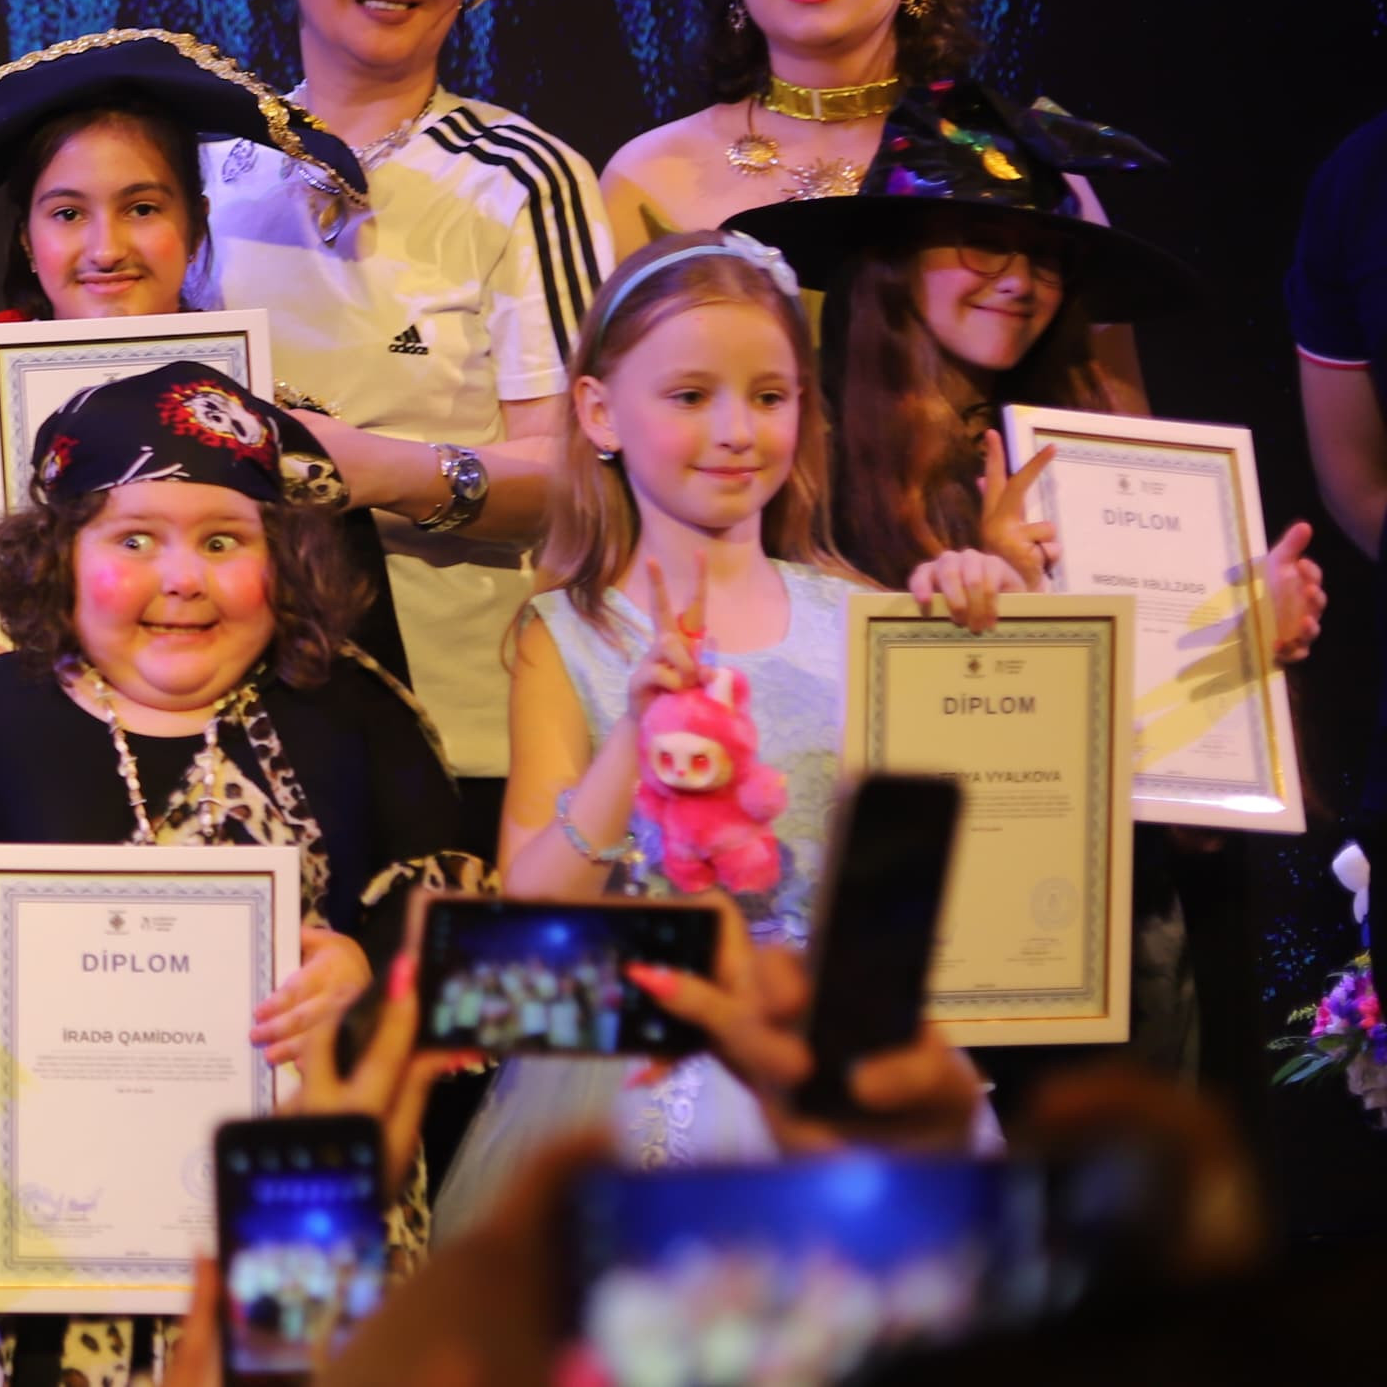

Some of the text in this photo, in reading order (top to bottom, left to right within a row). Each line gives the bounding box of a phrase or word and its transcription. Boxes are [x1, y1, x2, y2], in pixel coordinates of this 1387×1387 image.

[388, 343, 429, 355] adidas
[1102, 507, 1181, 532] DİPLOM
[942, 693, 1036, 715] DİPLOM
[81, 949, 191, 974] DİPLOM
[62, 1027, 207, 1047] İRADƏ QAMİDOVA
